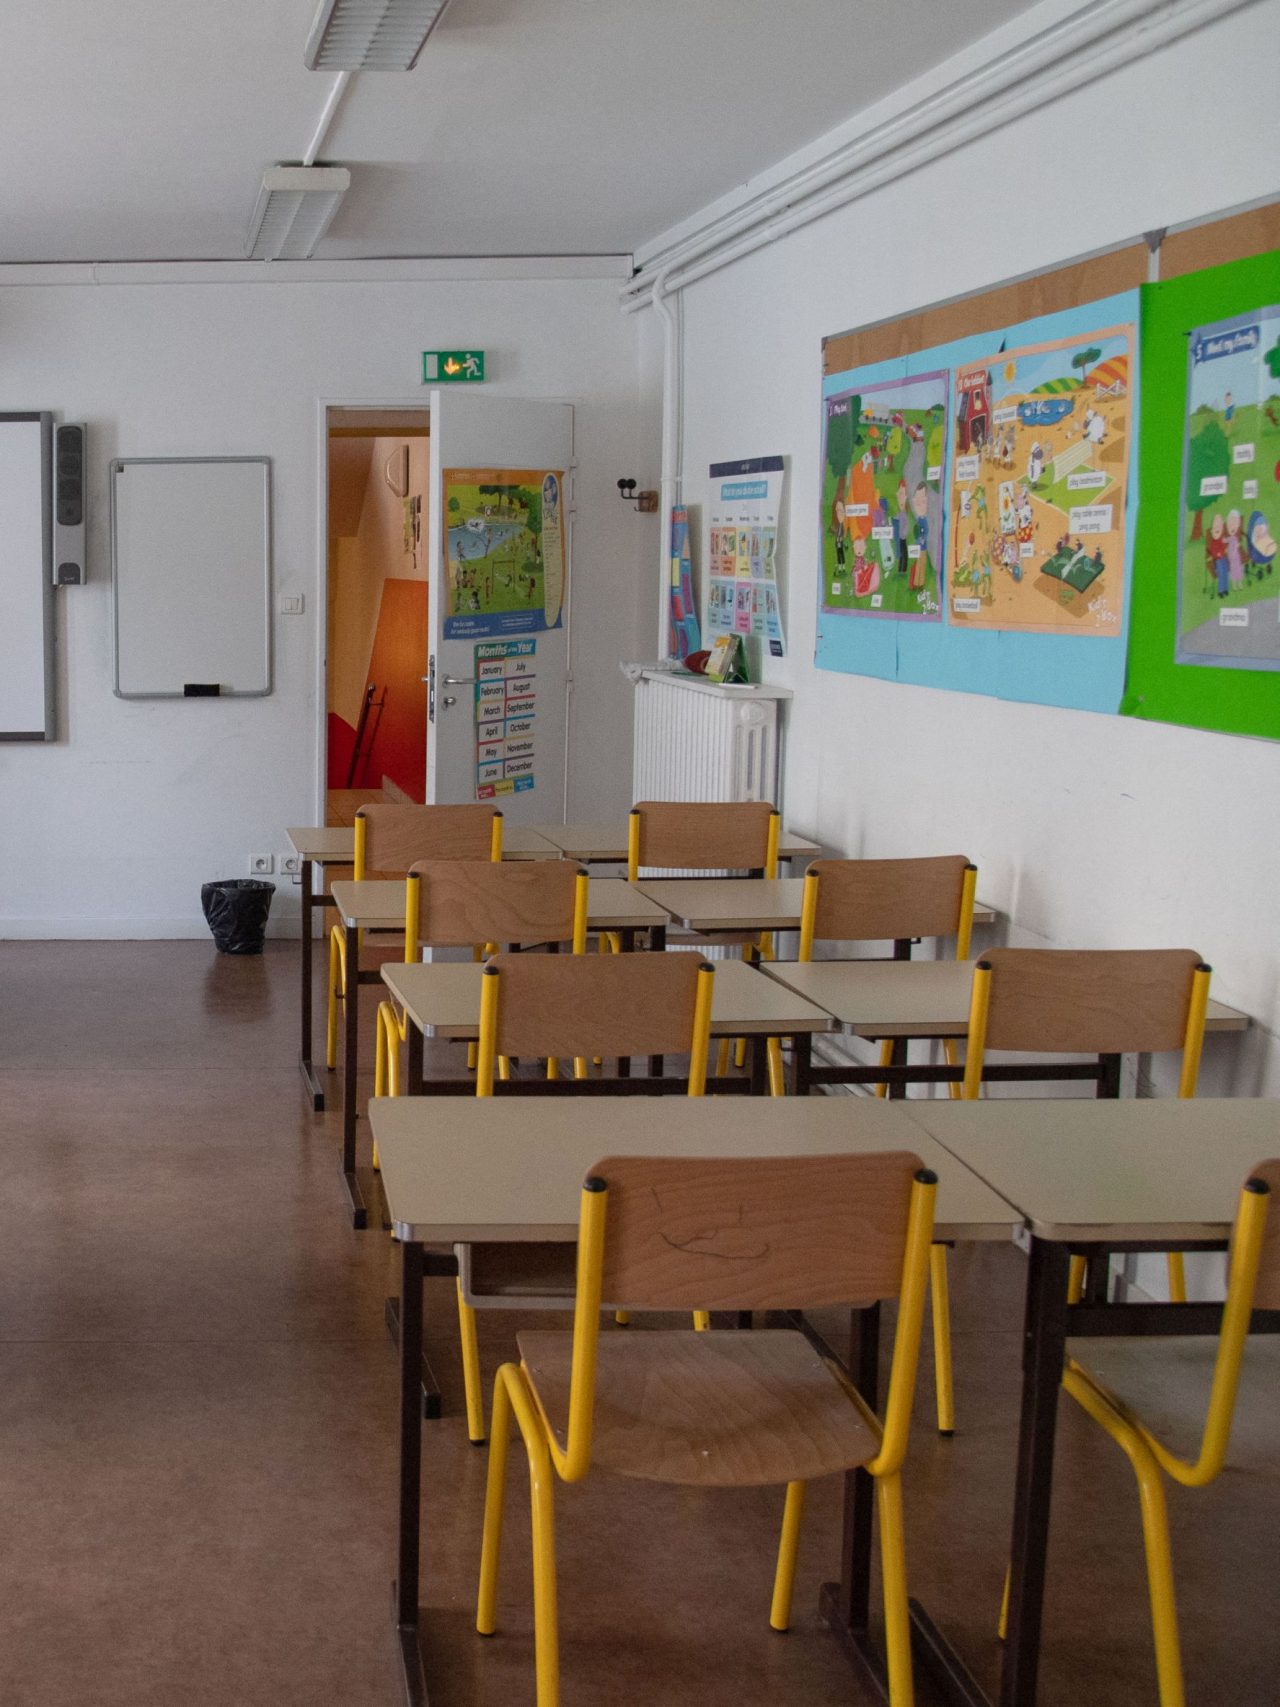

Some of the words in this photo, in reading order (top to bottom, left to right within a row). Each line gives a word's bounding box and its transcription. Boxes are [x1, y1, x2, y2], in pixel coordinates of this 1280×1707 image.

[478, 645, 508, 656] Months
[518, 642, 533, 653] Year
[481, 666, 503, 675] January
[515, 663, 526, 672] July
[480, 687, 504, 697] February
[513, 682, 530, 693] August
[483, 706, 501, 716] March
[507, 702, 535, 714] September
[485, 727, 498, 738] April
[510, 722, 531, 733] October
[485, 748, 497, 758] May
[507, 742, 533, 753] November
[507, 761, 533, 773] December
[484, 768, 497, 778] June
